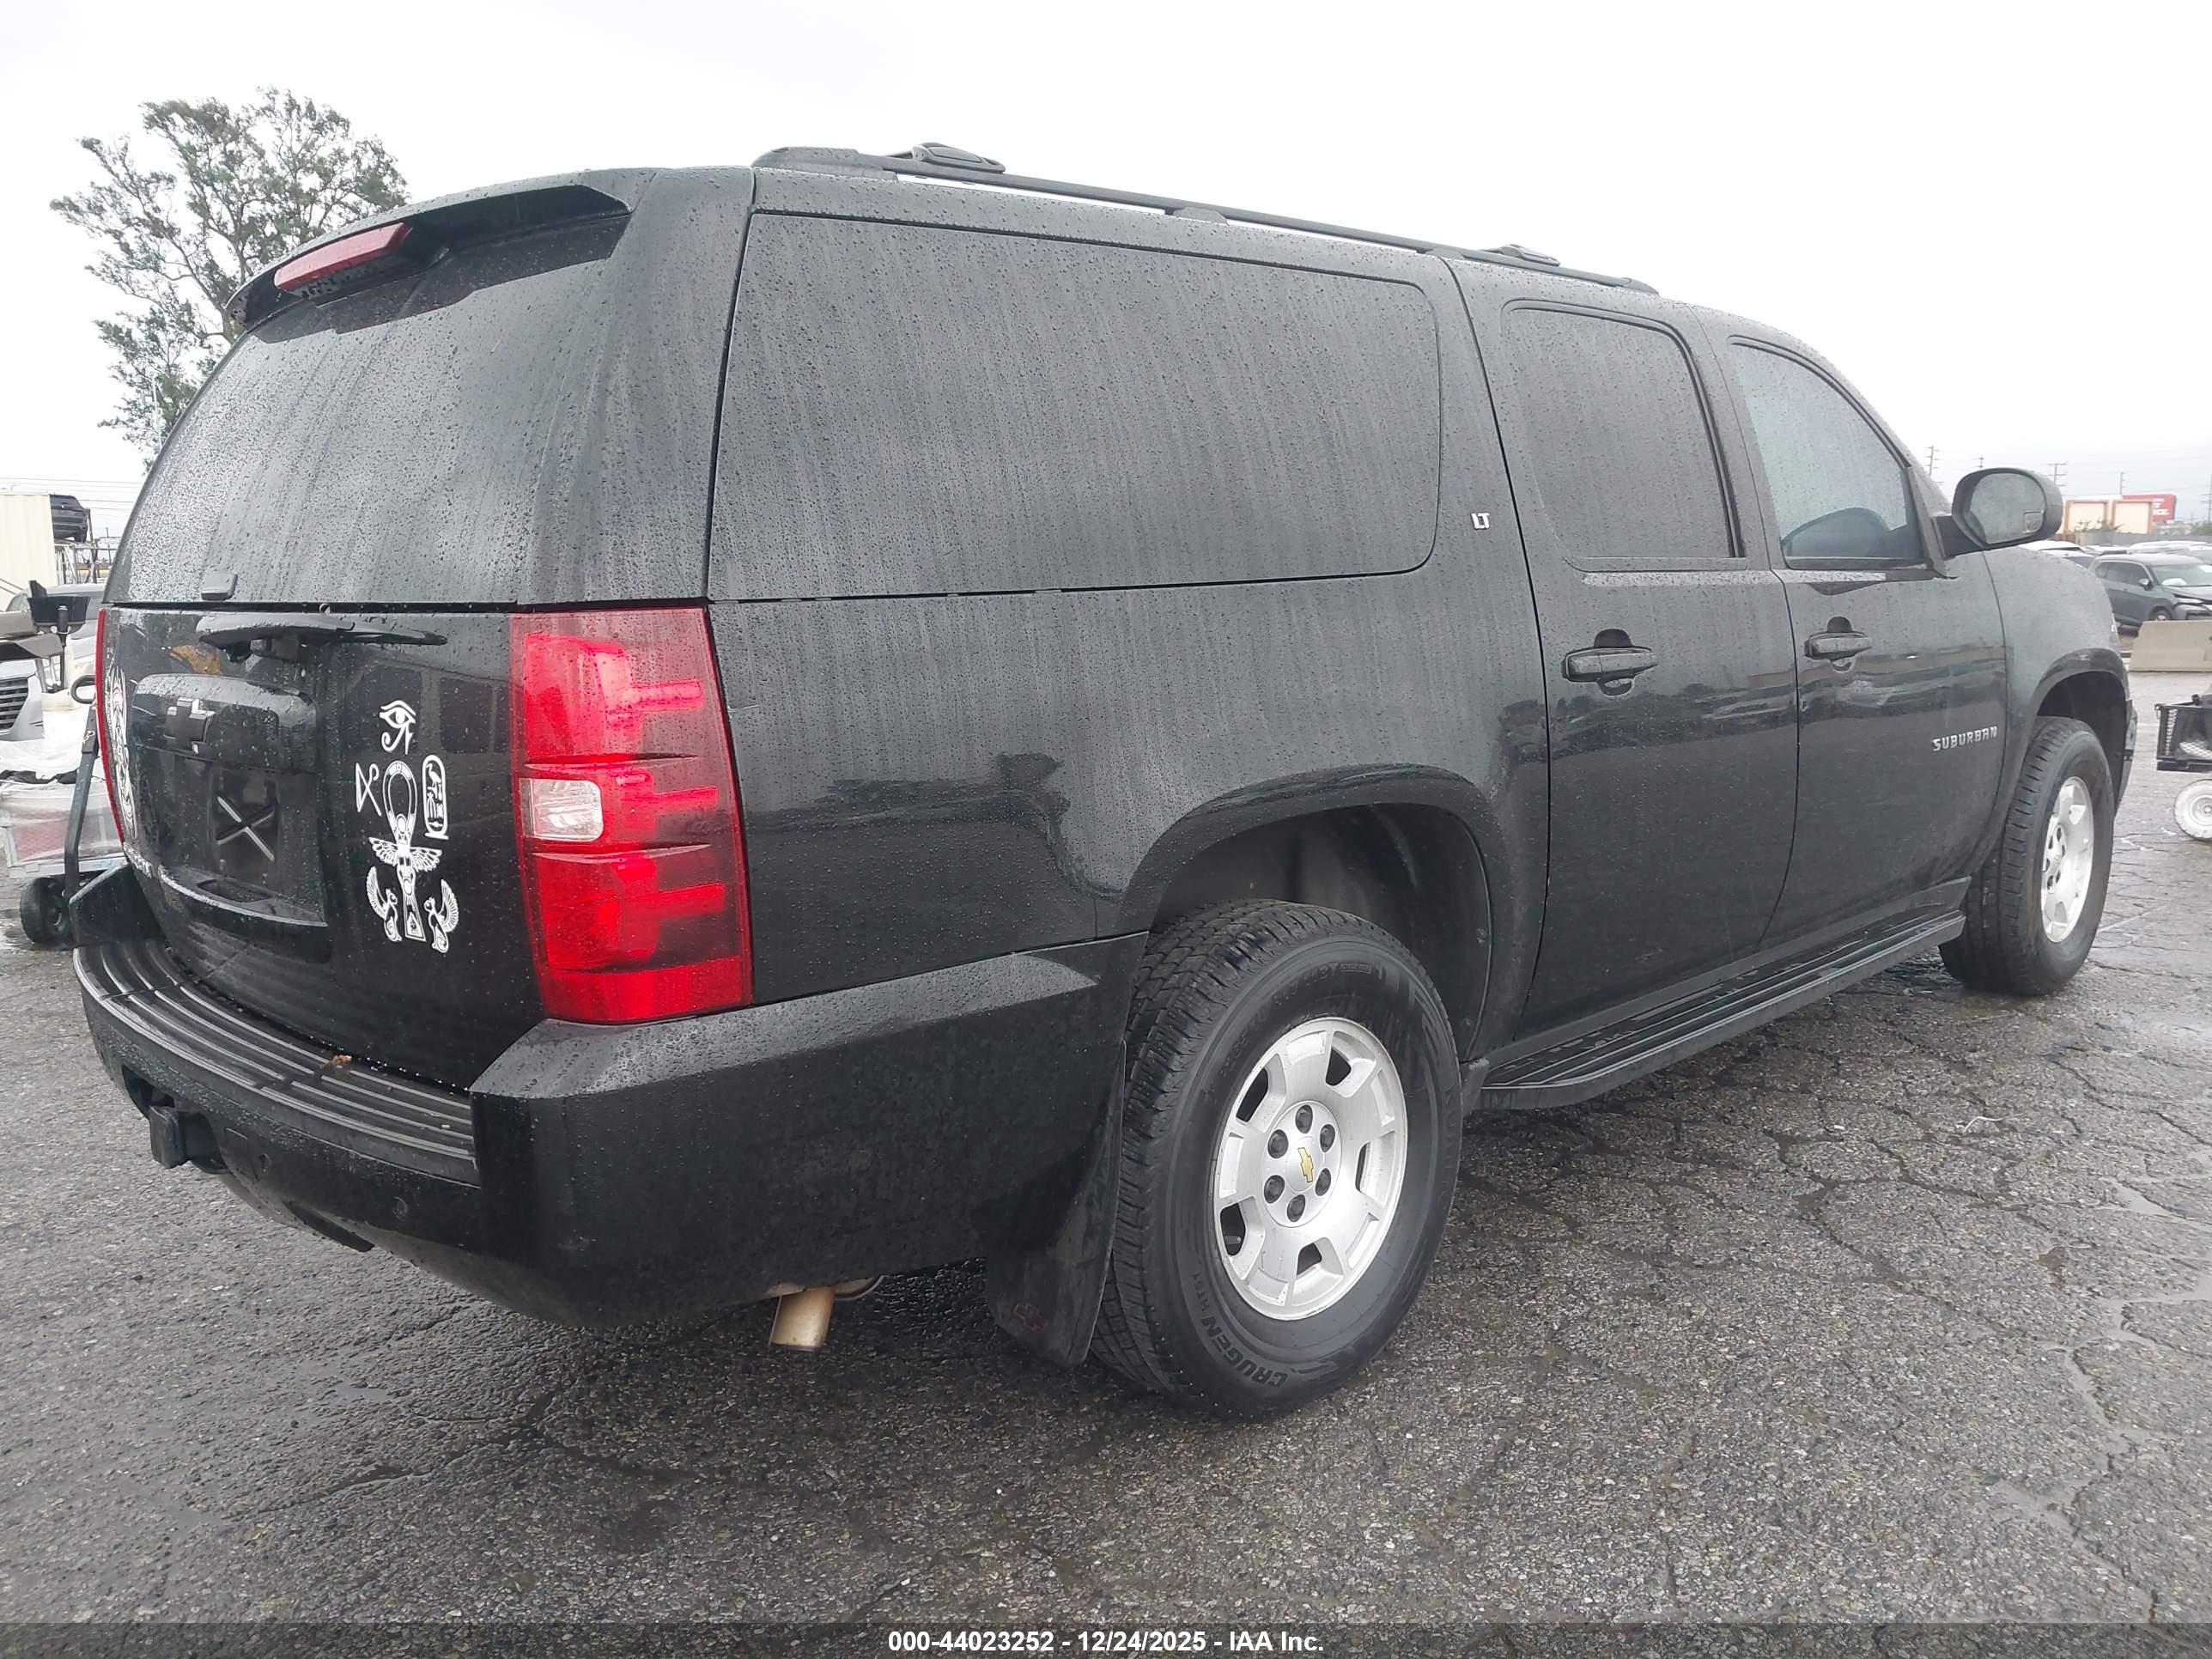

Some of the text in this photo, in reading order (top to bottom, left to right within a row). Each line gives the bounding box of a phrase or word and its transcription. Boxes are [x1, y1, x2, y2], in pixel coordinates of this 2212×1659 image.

[1471, 513, 1490, 529] LT
[1932, 725, 1998, 751] SUBURBAN
[1200, 1315, 1289, 1388] CRUGEN
